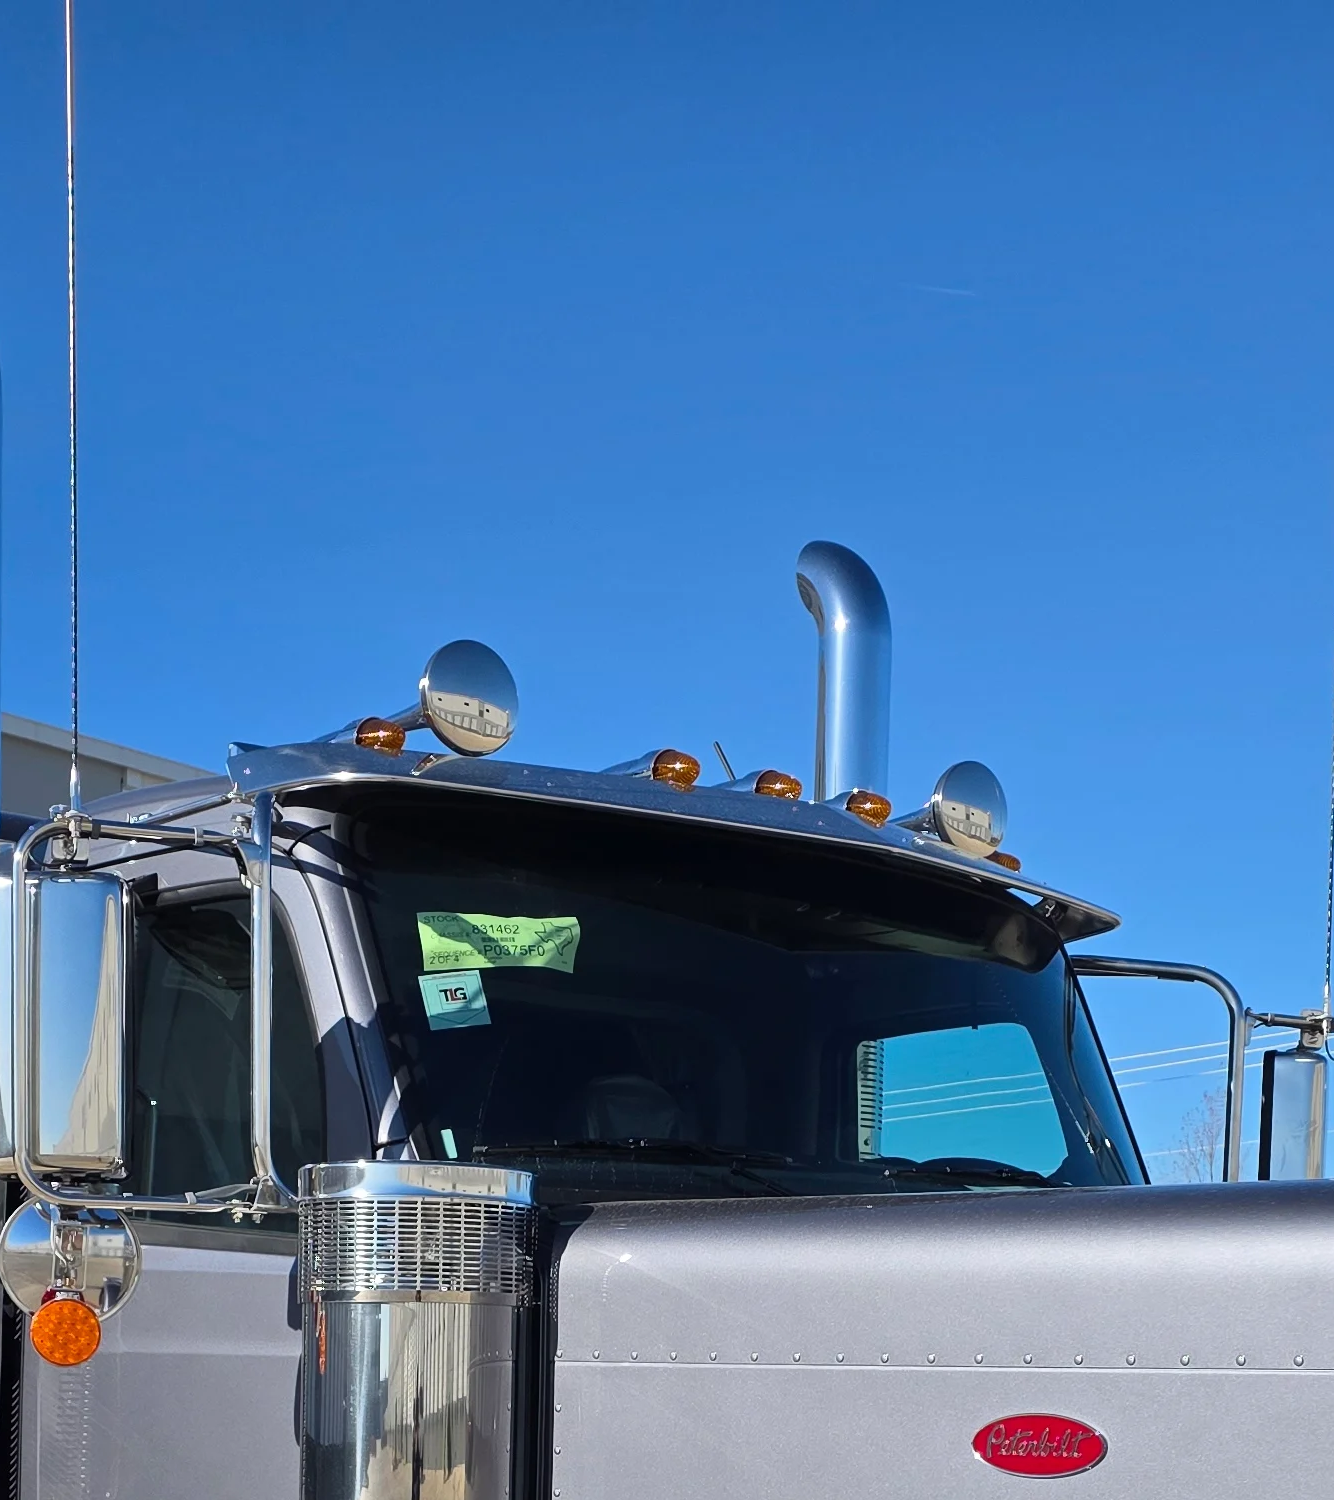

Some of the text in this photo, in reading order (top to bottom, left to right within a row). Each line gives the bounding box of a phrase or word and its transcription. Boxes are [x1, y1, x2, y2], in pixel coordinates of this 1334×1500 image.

[423, 915, 460, 924] STOCK
[471, 924, 520, 935] 831462
[483, 944, 545, 957] P0375F0
[429, 956, 436, 965] 2
[437, 955, 451, 965] OF
[439, 987, 468, 1002] TLG
[986, 1423, 1094, 1459] Peterbilt
